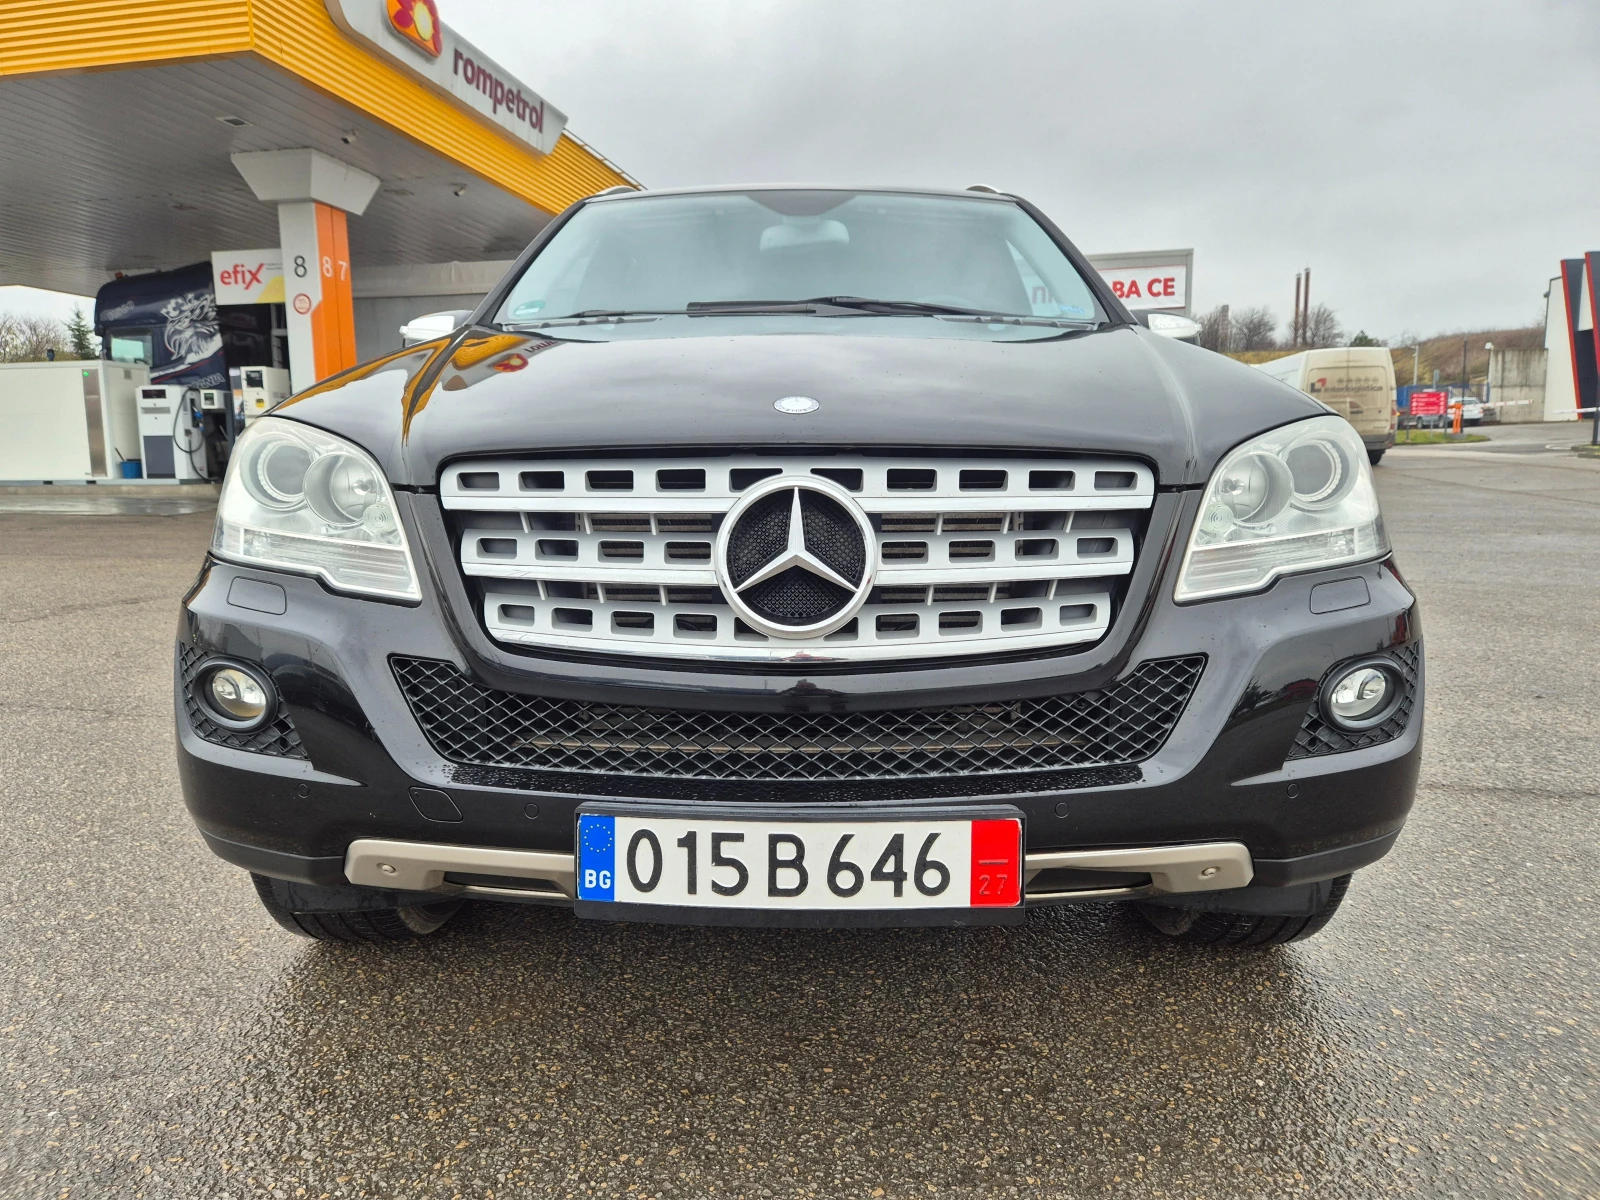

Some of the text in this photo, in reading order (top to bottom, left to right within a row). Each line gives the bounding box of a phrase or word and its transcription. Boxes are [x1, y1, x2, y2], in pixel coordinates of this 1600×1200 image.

[453, 47, 544, 134] rompetrol
[219, 263, 265, 290] efix
[293, 255, 308, 278] 8
[322, 256, 334, 278] 8
[338, 260, 348, 281] 7
[584, 869, 612, 889] BG
[978, 873, 1008, 895] 27
